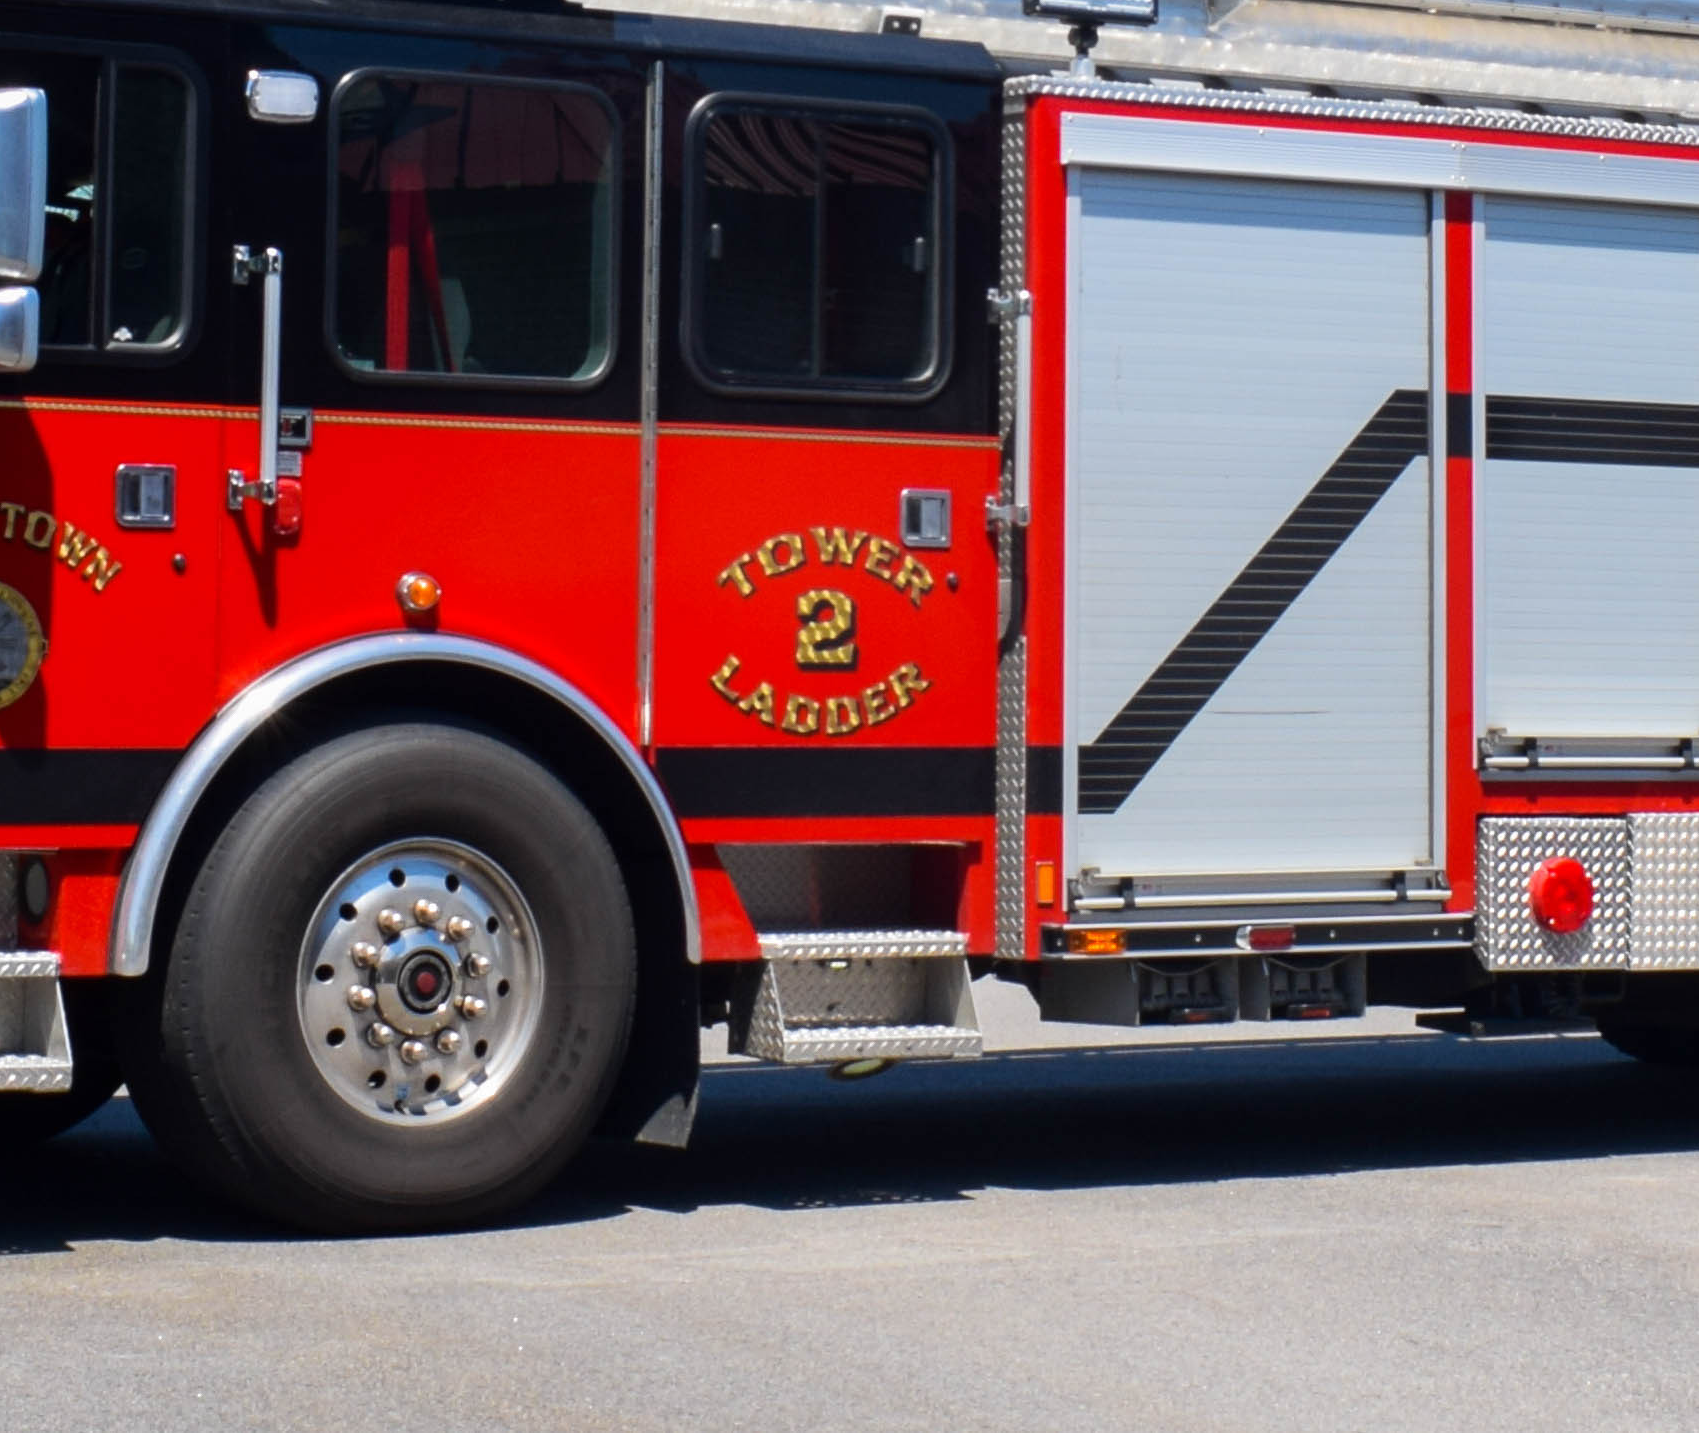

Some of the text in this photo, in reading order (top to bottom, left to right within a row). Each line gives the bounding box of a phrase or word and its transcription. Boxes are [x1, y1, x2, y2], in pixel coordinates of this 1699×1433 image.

[716, 527, 935, 608] TOWER
[796, 589, 856, 671] 2
[710, 654, 932, 735] LADDER
